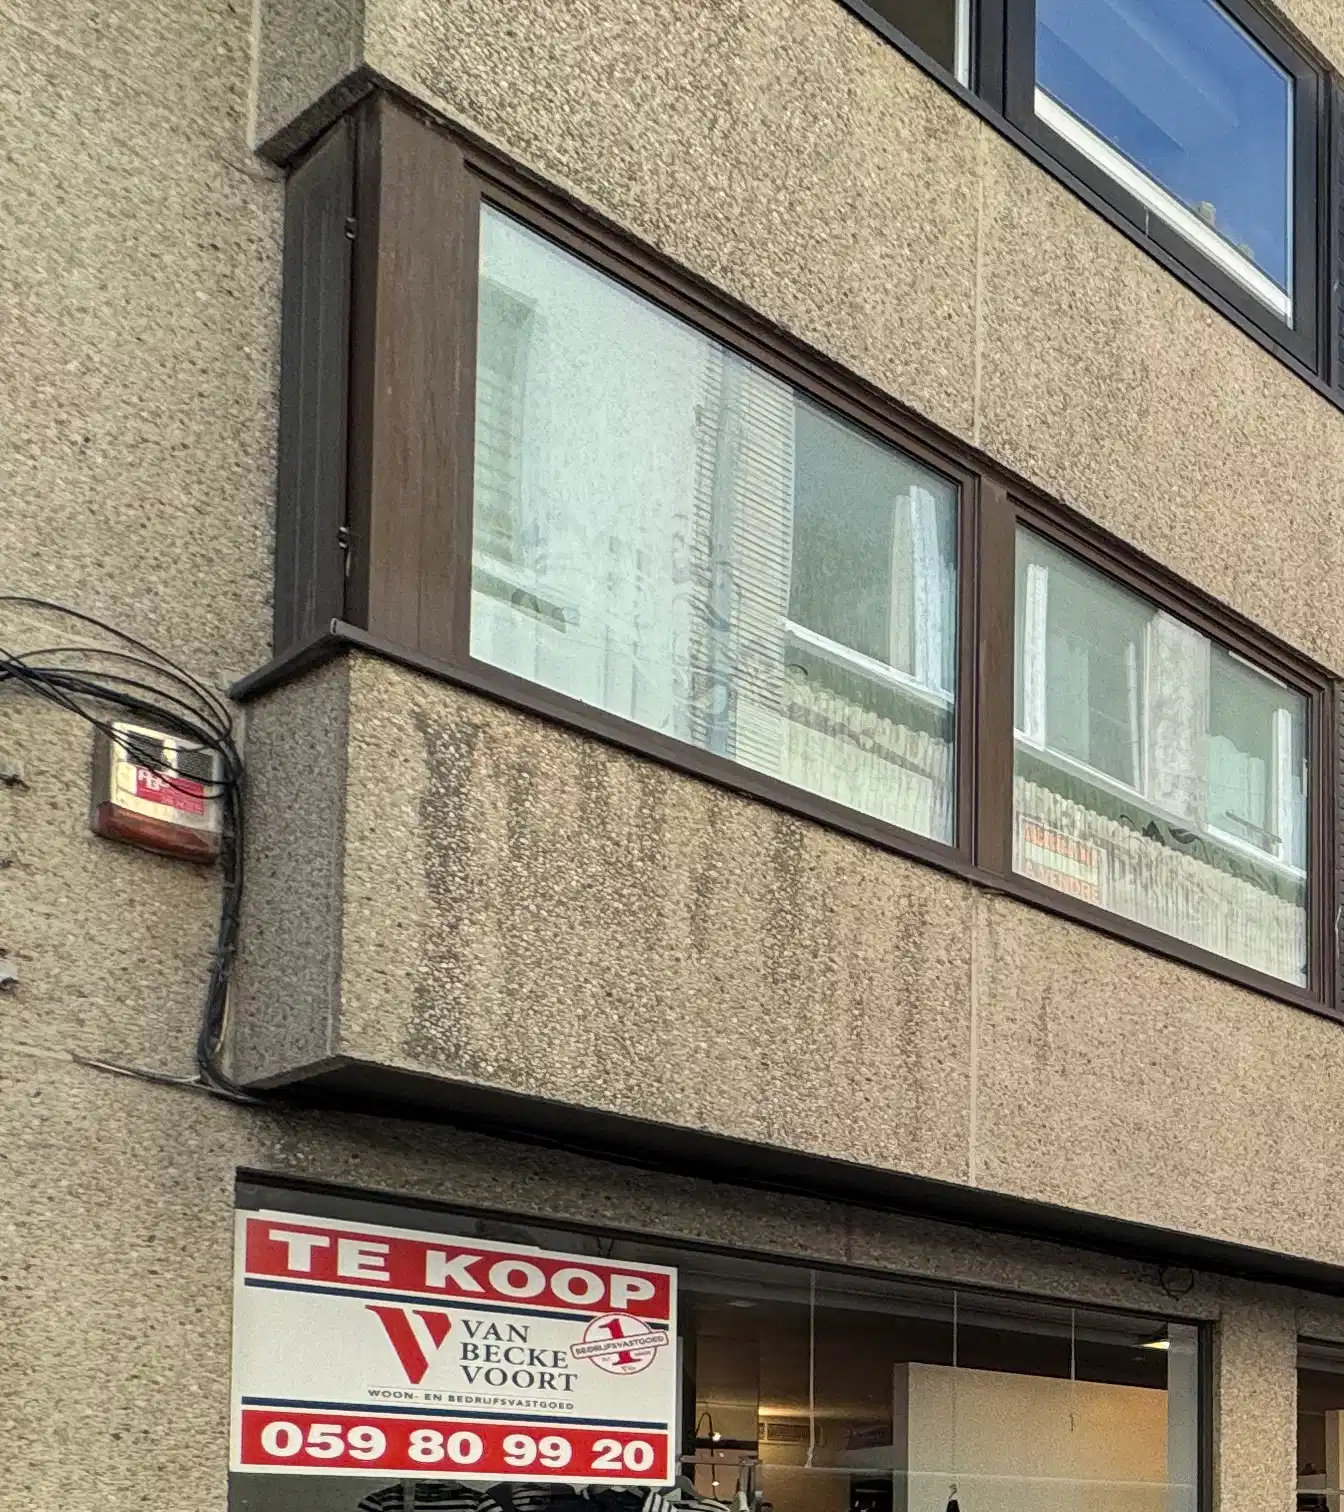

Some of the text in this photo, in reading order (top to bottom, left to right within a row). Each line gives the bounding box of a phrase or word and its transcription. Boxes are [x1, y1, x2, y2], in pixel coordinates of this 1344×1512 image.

[268, 1229, 656, 1309] TE KOOP
[459, 1319, 530, 1344] VAN
[459, 1342, 569, 1370] BECKE
[459, 1365, 579, 1393] VOORT
[367, 1389, 419, 1400] WOON-
[425, 1393, 442, 1401] EN
[260, 1420, 655, 1470] 059 80 99 20
